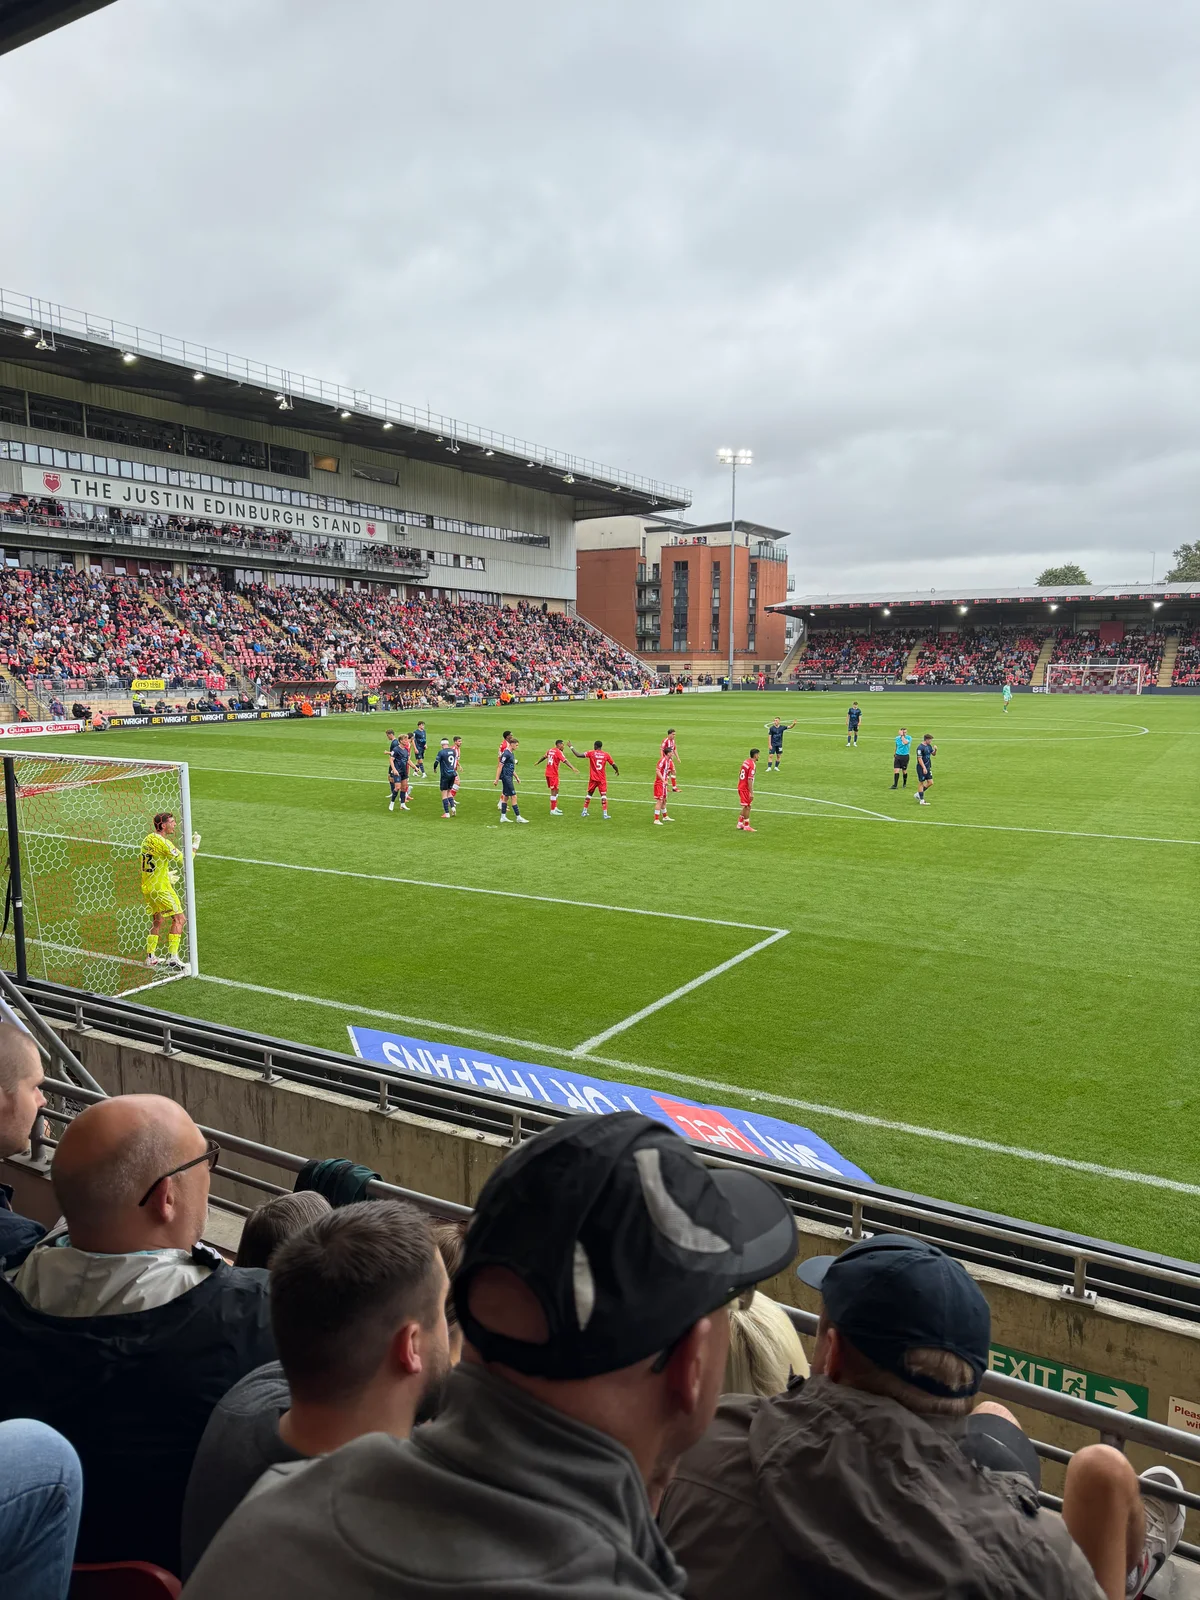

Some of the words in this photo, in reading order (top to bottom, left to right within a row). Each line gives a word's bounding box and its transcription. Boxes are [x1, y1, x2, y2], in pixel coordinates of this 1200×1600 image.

[71, 478, 112, 499] THE
[123, 486, 195, 511] JUSTIN
[204, 498, 306, 527] EDINBURGH
[312, 515, 362, 535] STAND
[111, 716, 149, 726] BETWRIGHT
[152, 715, 188, 724] BETWRIGHT
[190, 714, 225, 722] BETWRIGHT
[226, 712, 258, 721] BETWRIGHT
[9, 726, 42, 734] QUATTRO
[447, 755, 455, 767] 9
[595, 760, 603, 771] 5
[988, 1350, 1057, 1389] EXIT
